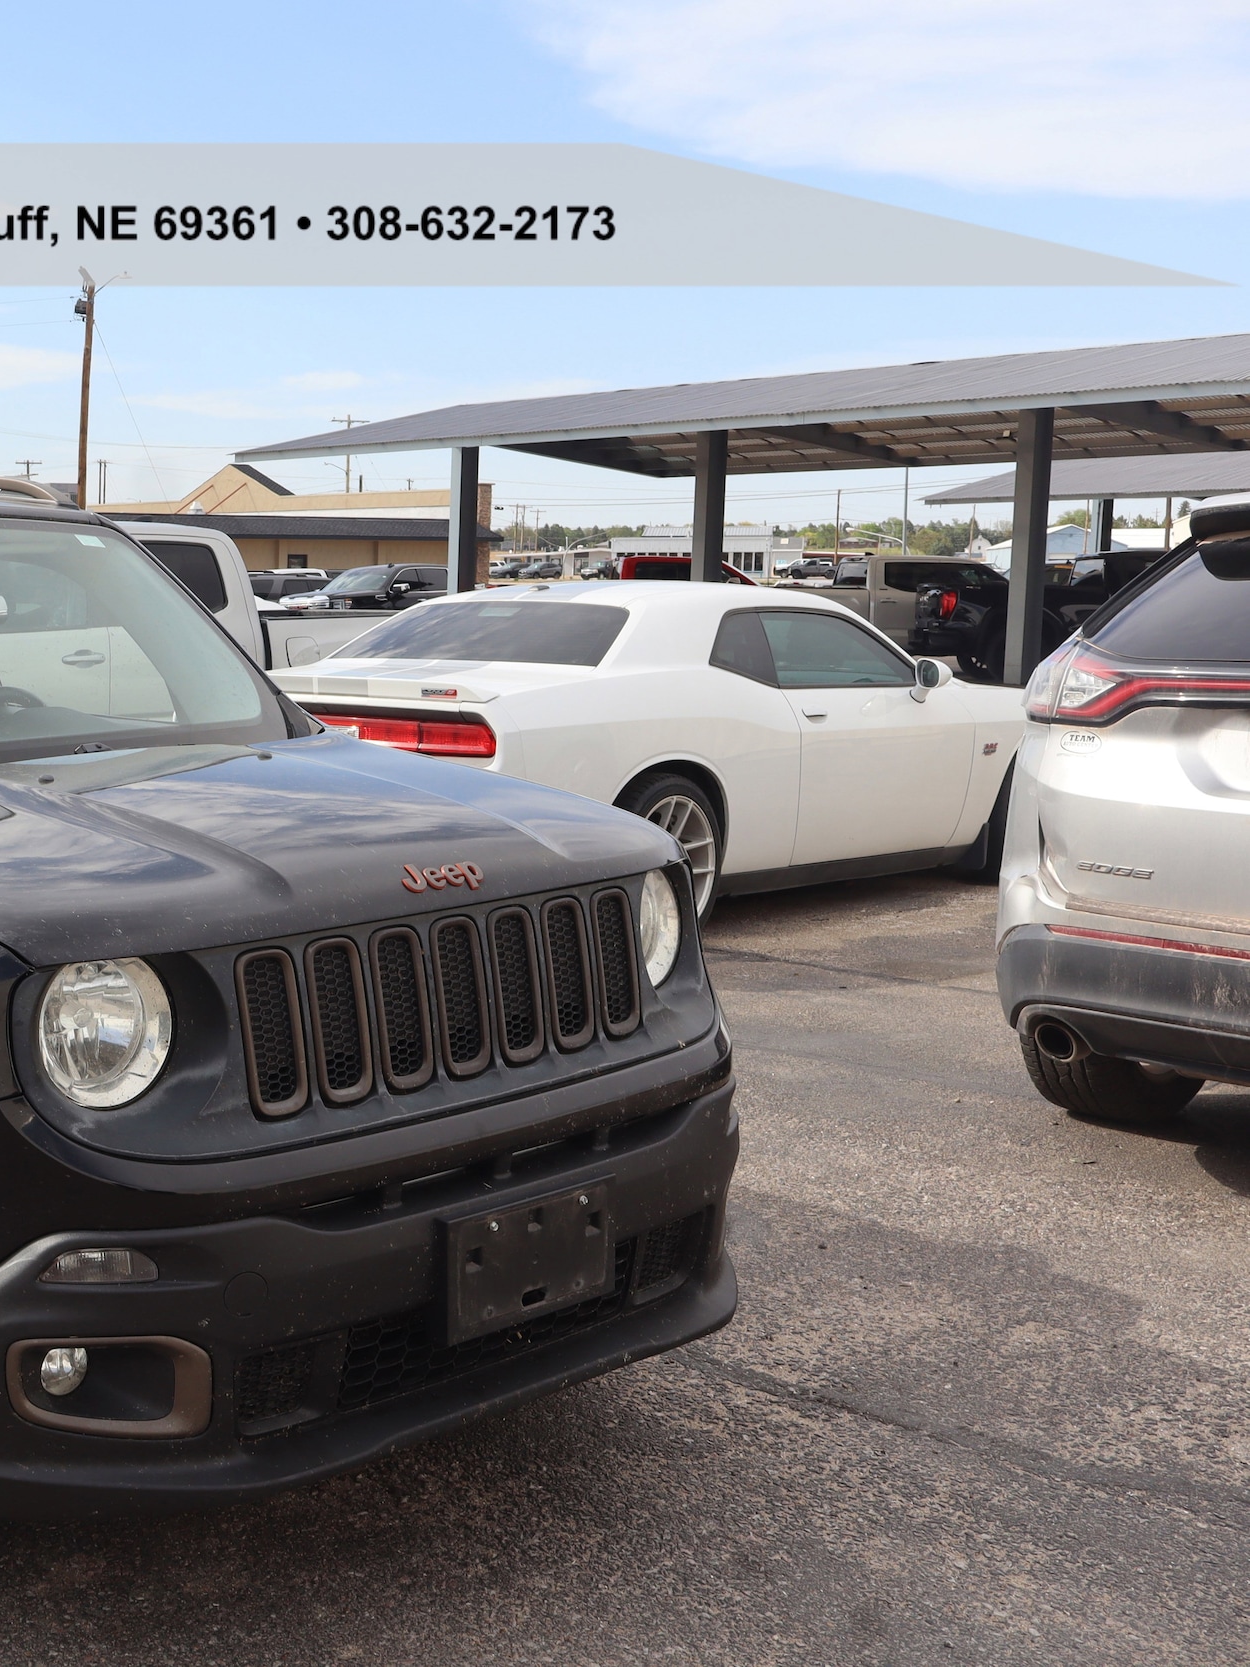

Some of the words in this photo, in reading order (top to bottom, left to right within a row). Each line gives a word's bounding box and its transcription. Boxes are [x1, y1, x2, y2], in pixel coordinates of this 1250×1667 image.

[1069, 734, 1095, 743] TEAM
[401, 860, 484, 893] Jeep
[1077, 860, 1154, 880] EDGE
